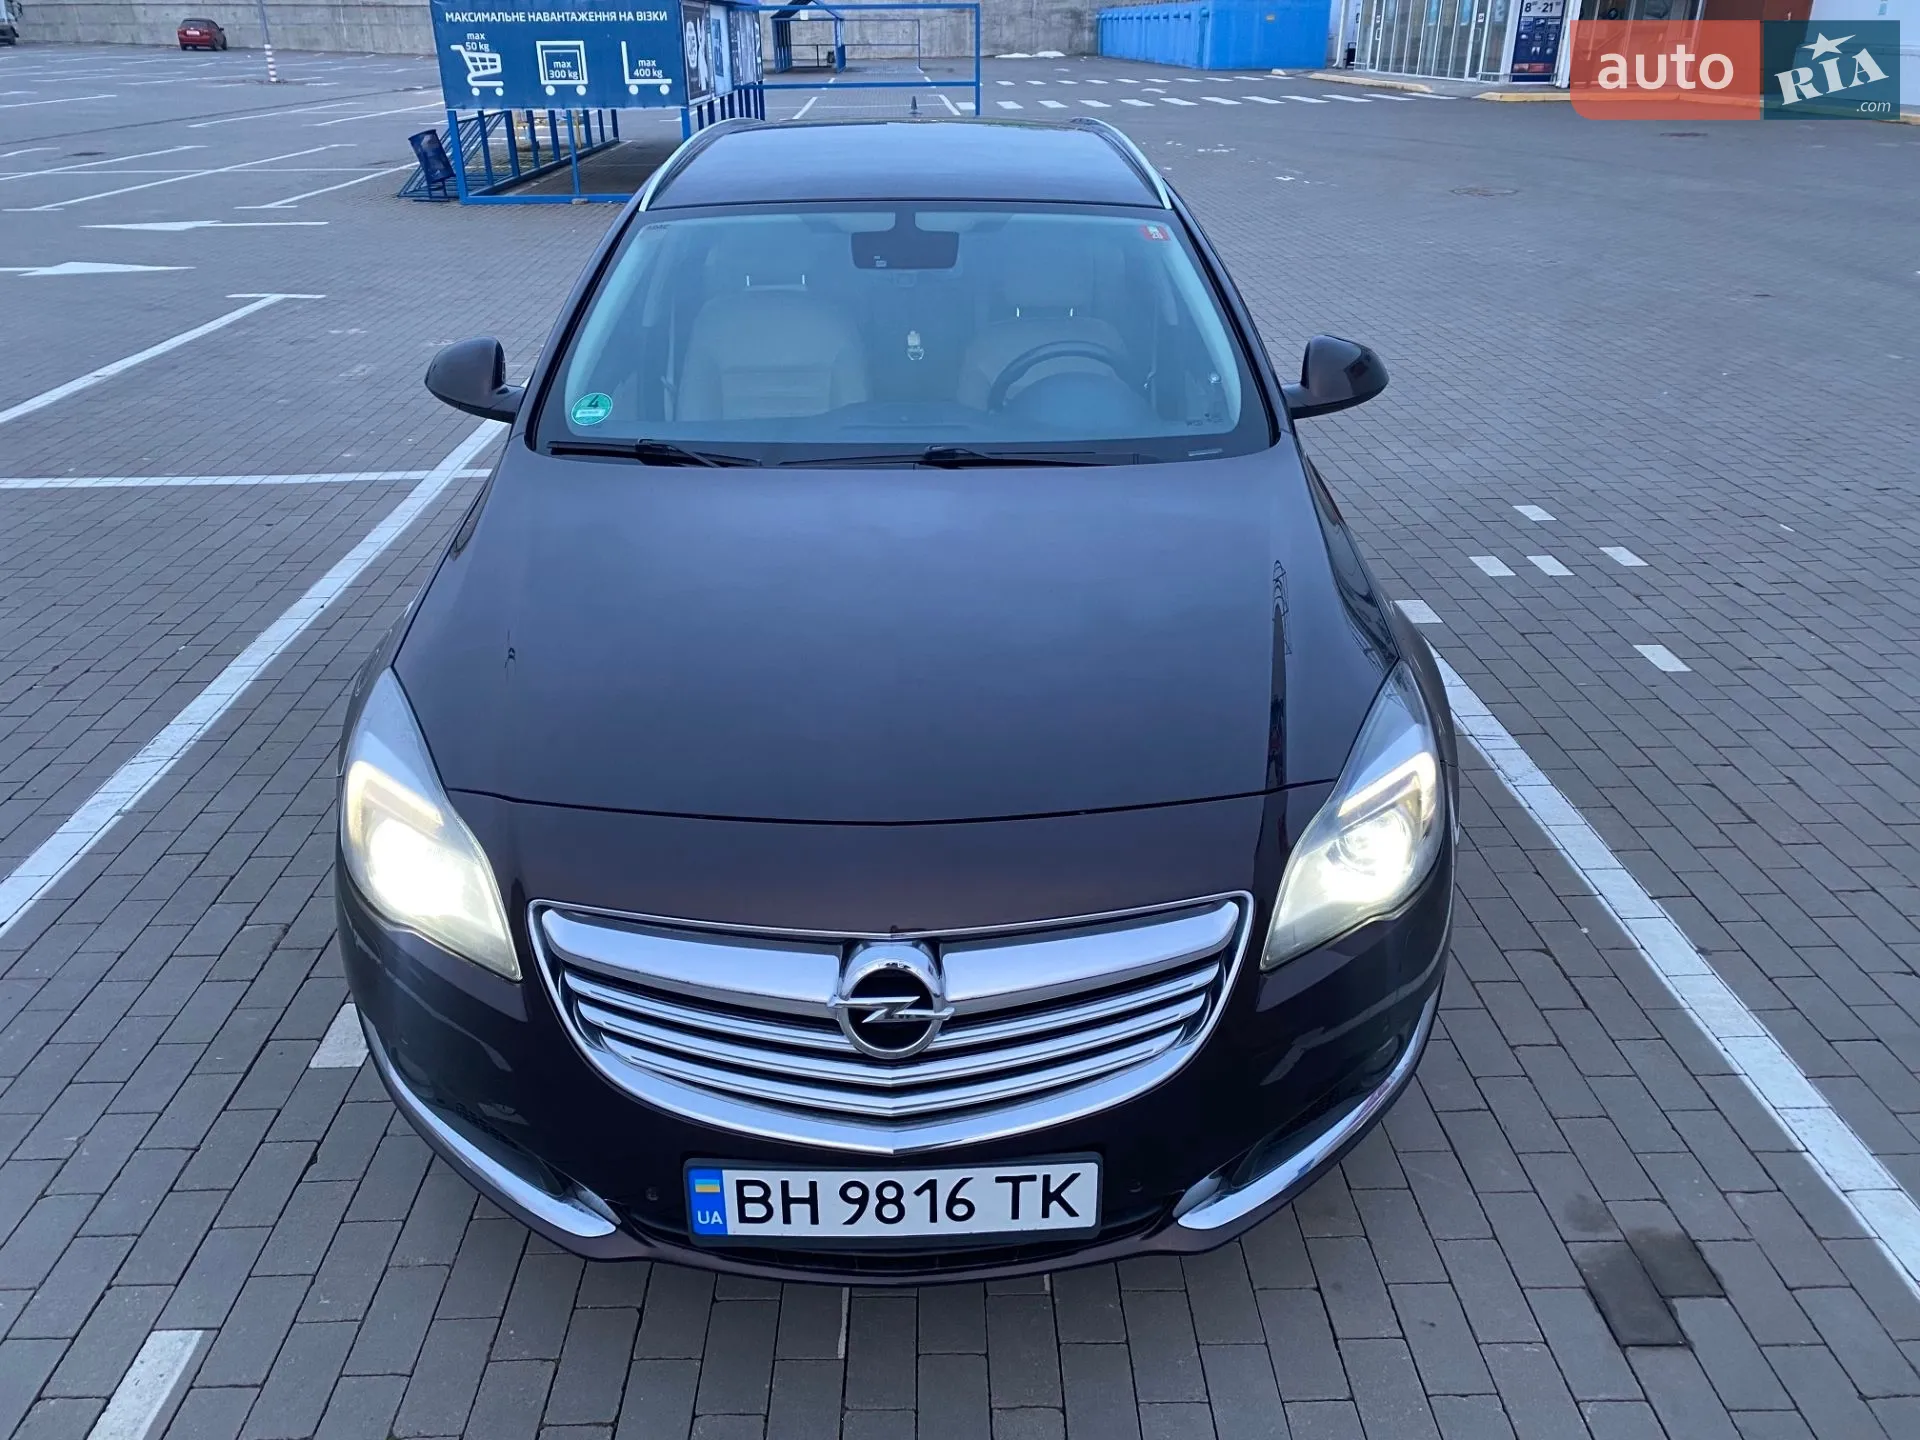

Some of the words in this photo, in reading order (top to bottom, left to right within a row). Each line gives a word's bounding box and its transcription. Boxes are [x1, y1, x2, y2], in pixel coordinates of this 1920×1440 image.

[445, 12, 526, 22] МАКСИМАЛЬНЕ
[528, 11, 616, 22] НАВАНТАЖЕННЯ
[619, 11, 634, 21] НА
[636, 11, 668, 21] ВІЗКИ
[465, 42, 477, 51] 50
[479, 42, 490, 52] kg
[638, 59, 657, 67] max
[549, 70, 566, 78] 300
[568, 70, 579, 80] kg
[633, 68, 651, 77] 400
[652, 68, 663, 78] kg
[587, 394, 600, 408] 4
[735, 1179, 820, 1226] BH
[838, 1176, 976, 1226] 9816
[994, 1172, 1082, 1221] TK
[697, 1211, 724, 1226] UA
